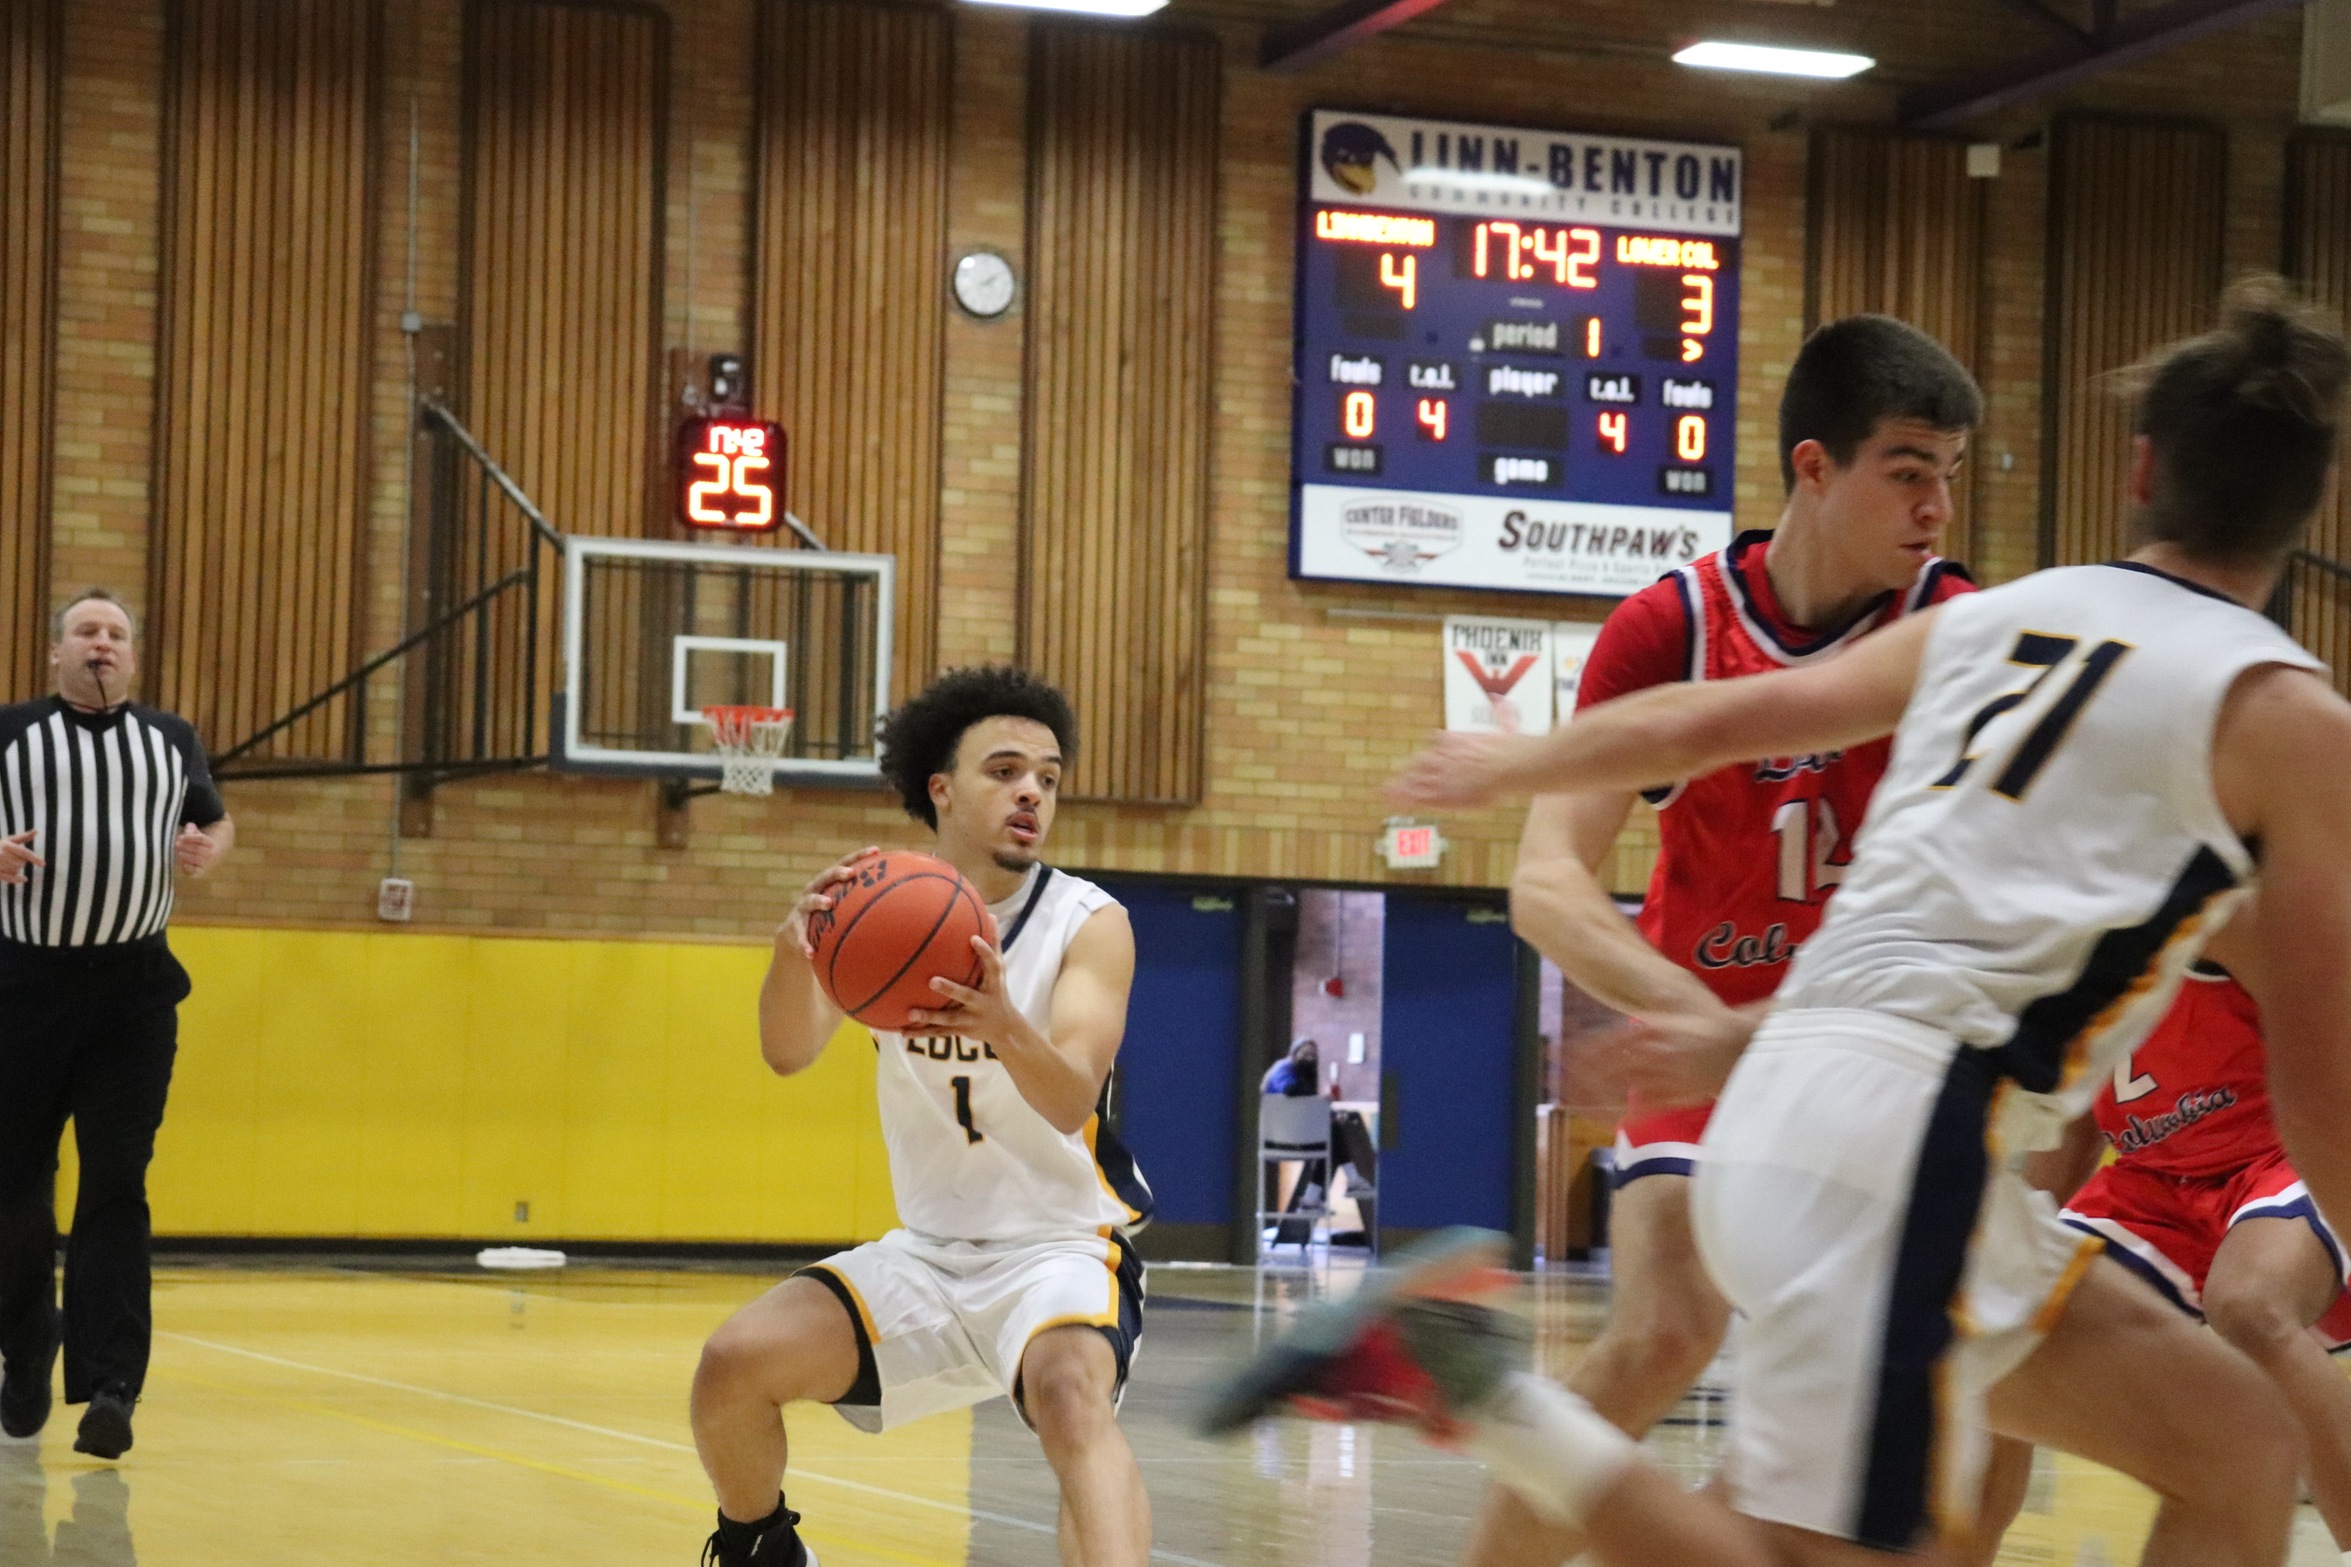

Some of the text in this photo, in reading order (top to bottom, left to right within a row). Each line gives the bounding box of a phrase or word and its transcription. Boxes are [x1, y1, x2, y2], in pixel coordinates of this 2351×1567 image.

[1380, 252, 1417, 309] 4
[1474, 221, 1601, 289] 17:42
[1681, 274, 1714, 335] 3
[1587, 317, 1601, 358] 1
[1346, 391, 1375, 438] 0
[1418, 398, 1447, 441] 4
[1599, 412, 1627, 453] 4
[1677, 415, 1706, 461] 0
[688, 452, 773, 526] 25
[1452, 624, 1543, 651] PHOENIX
[1928, 629, 2137, 804] 21
[949, 1074, 985, 1146] 1
